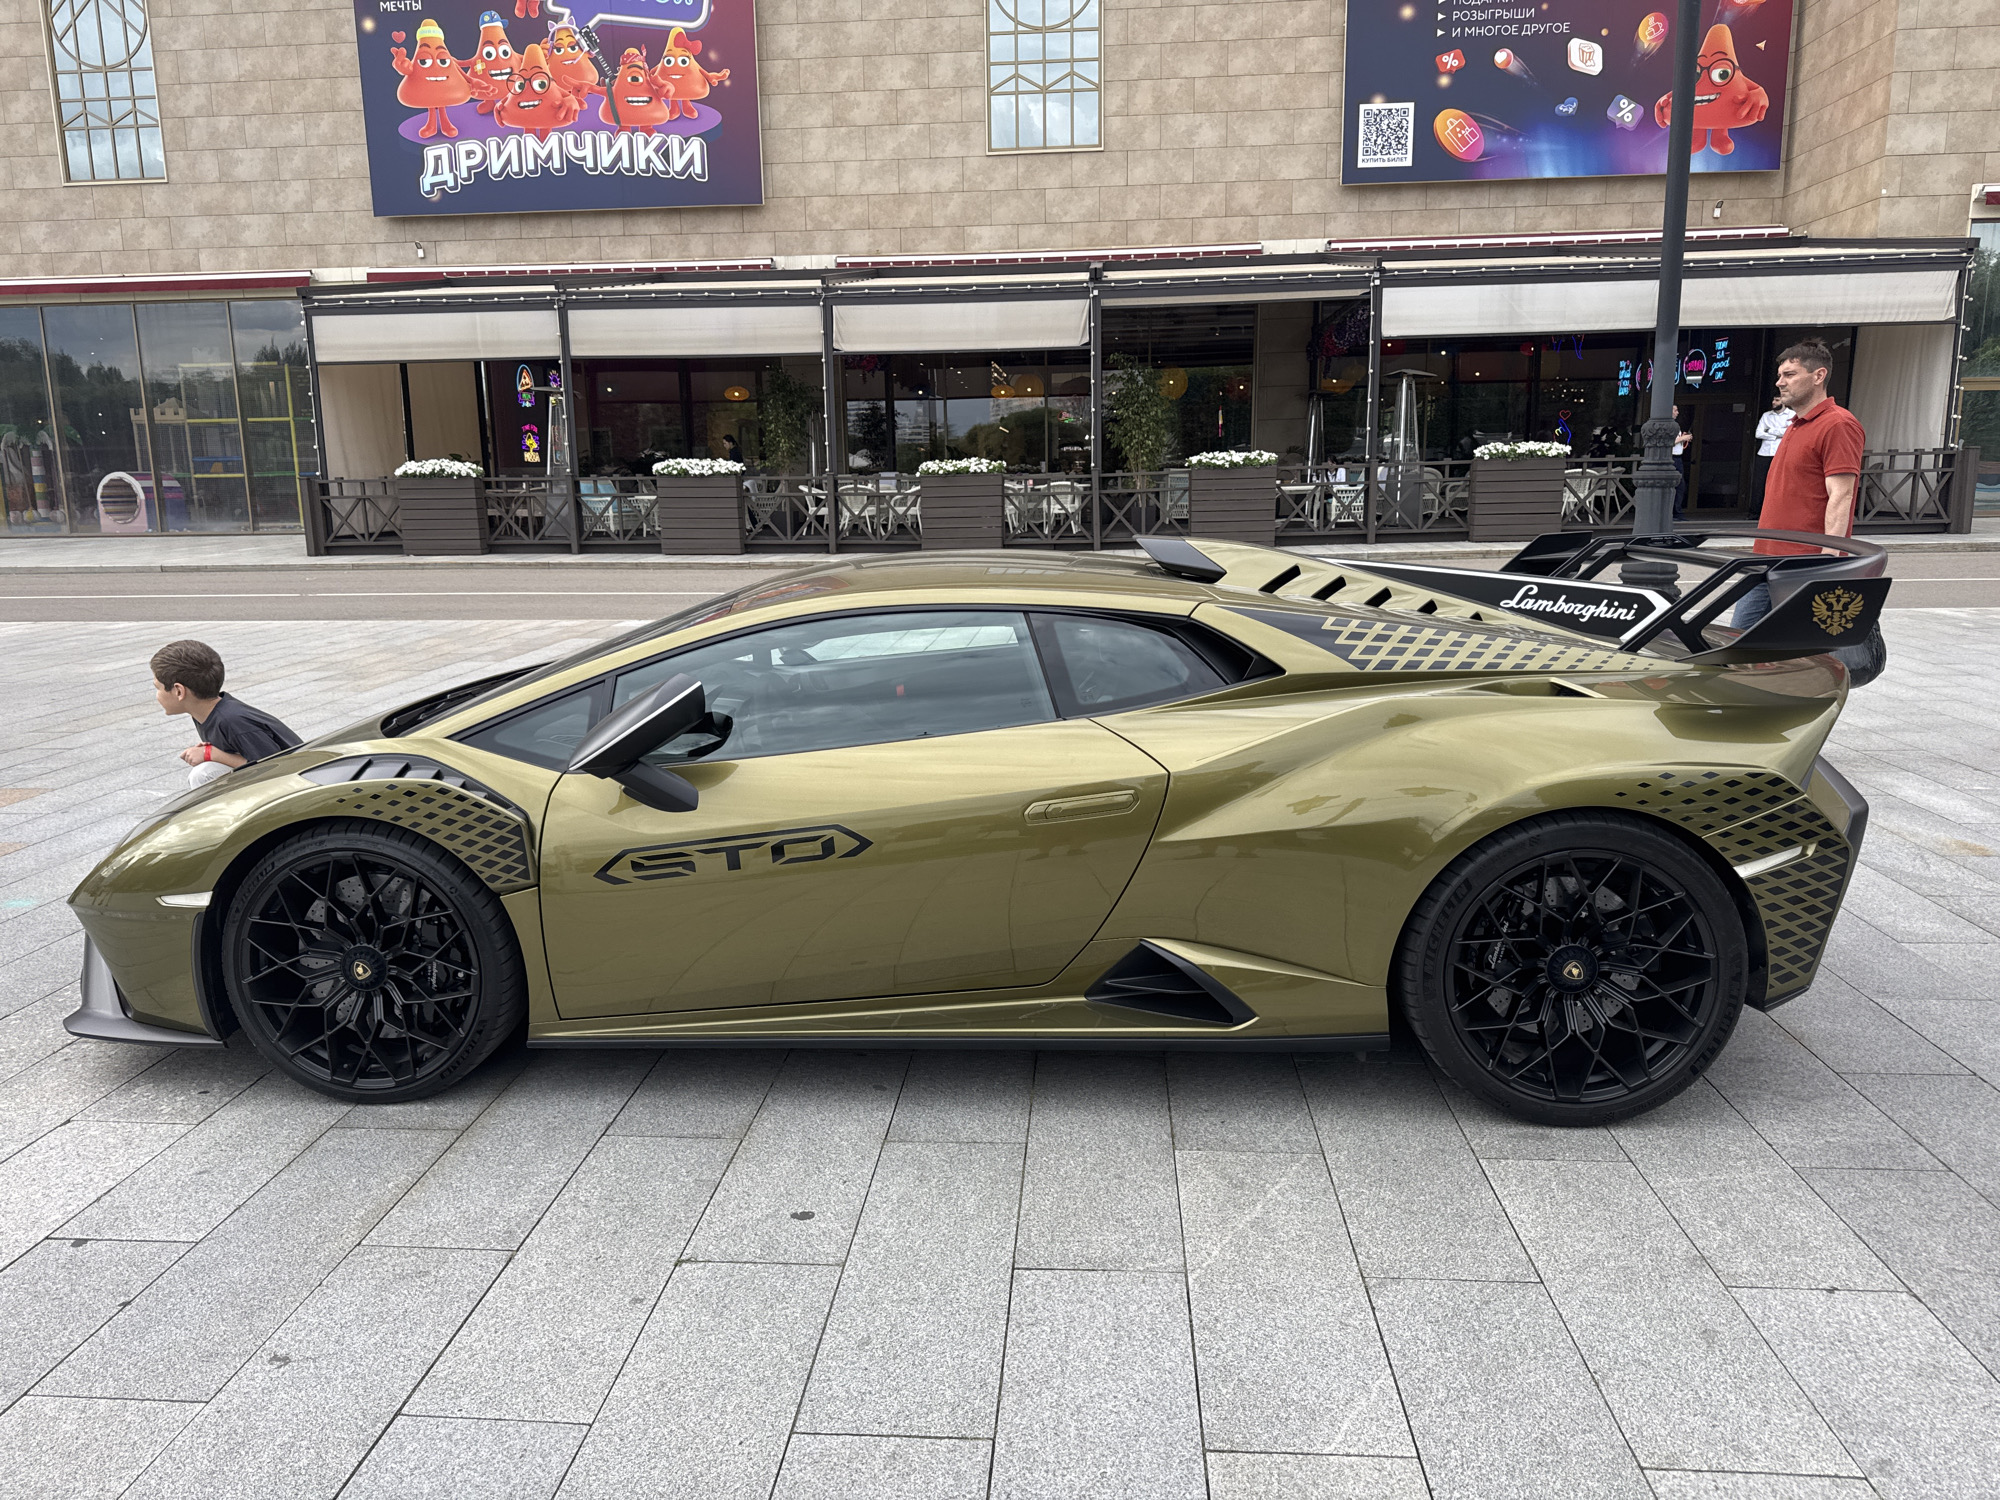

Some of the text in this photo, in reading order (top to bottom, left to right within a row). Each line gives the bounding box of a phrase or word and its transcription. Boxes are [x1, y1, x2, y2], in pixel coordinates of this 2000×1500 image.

[380, 0, 422, 12] МЕЧТЫ
[1453, 8, 1535, 21] РОЗЫГРЫШИ
[1452, 22, 1570, 38] И МНОГОЕ ДРУГОЕ
[420, 131, 708, 197] ДРИМЧИКИ
[1500, 584, 1638, 622] Lamborghini
[630, 834, 836, 881] STO
[1423, 880, 1471, 976] MICHELIN
